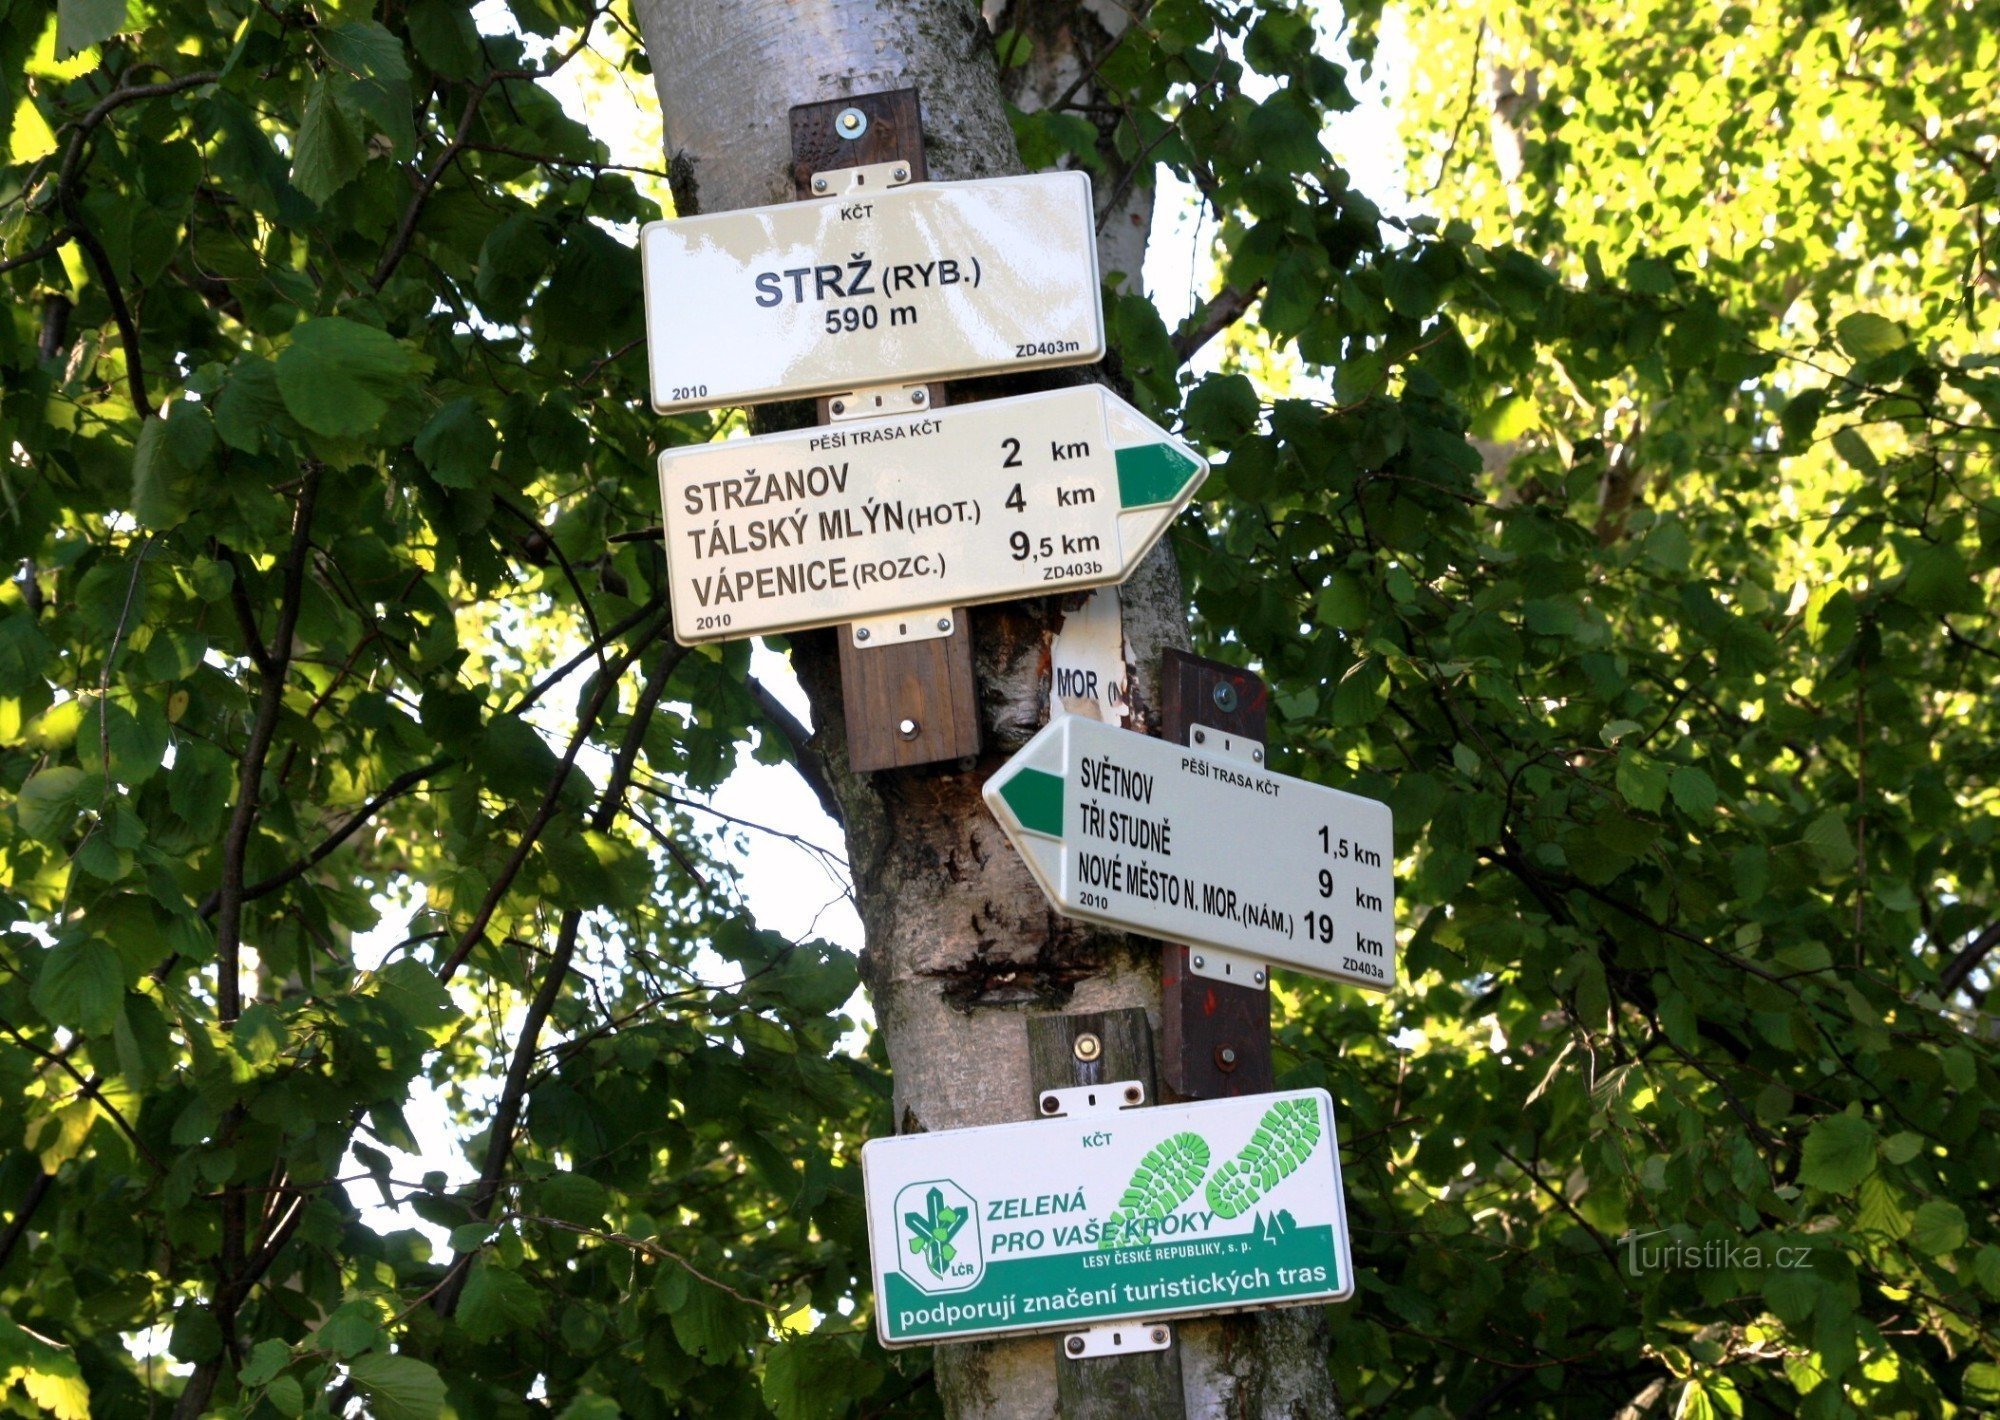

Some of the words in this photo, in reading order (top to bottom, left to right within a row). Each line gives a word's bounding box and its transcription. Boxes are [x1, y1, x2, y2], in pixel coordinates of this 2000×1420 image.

[841, 204, 873, 221] KČT
[825, 305, 878, 335] 590
[891, 306, 917, 327] m
[1015, 340, 1080, 359] ZD403m
[672, 385, 707, 401] 2010
[809, 433, 846, 452] PĚŠÍ
[850, 426, 906, 445] TRASA
[910, 420, 942, 436] KČT
[684, 463, 849, 515] STRŽANOV
[1002, 438, 1023, 468] 2
[1051, 439, 1090, 461] km
[688, 508, 808, 559] TÁLSKÝ
[1005, 484, 1027, 513] 4
[1057, 485, 1095, 507] km
[1061, 533, 1100, 556] km
[1043, 562, 1103, 581] ZD403b
[696, 614, 731, 630] 2010
[1057, 668, 1098, 699] MOR
[1181, 758, 1209, 776] PĚŠÍ
[1213, 766, 1254, 789] TRASA
[1256, 778, 1280, 797] KČT
[1081, 755, 1153, 805] SVĚTNOV
[1354, 842, 1380, 867] km
[1080, 798, 1104, 839] TŘI
[1109, 811, 1171, 856] STUDNĚ
[1319, 870, 1333, 898] 9
[1356, 887, 1382, 912] km
[1079, 852, 1122, 892] NOVÉ
[1127, 859, 1180, 903] MĚSTO
[1184, 880, 1199, 911] N.
[1304, 911, 1333, 944] 19
[1356, 933, 1383, 956] km
[1080, 892, 1108, 910] 2010
[1342, 956, 1384, 979] ZD403a
[1082, 1132, 1113, 1148] KČT
[987, 1187, 1087, 1222] ZELENÁ
[991, 1232, 1045, 1255] PRO
[1054, 1221, 1116, 1247] VAŠE
[1125, 1210, 1216, 1241] KROKY
[1082, 1254, 1111, 1269] LESY
[1114, 1246, 1151, 1266] ČESKÉ
[1155, 1243, 1225, 1263] REPUBLIKY,
[900, 1297, 1017, 1331] podporují
[1023, 1287, 1117, 1312] značení
[1123, 1272, 1270, 1301] turistických
[1276, 1265, 1326, 1287] tras
